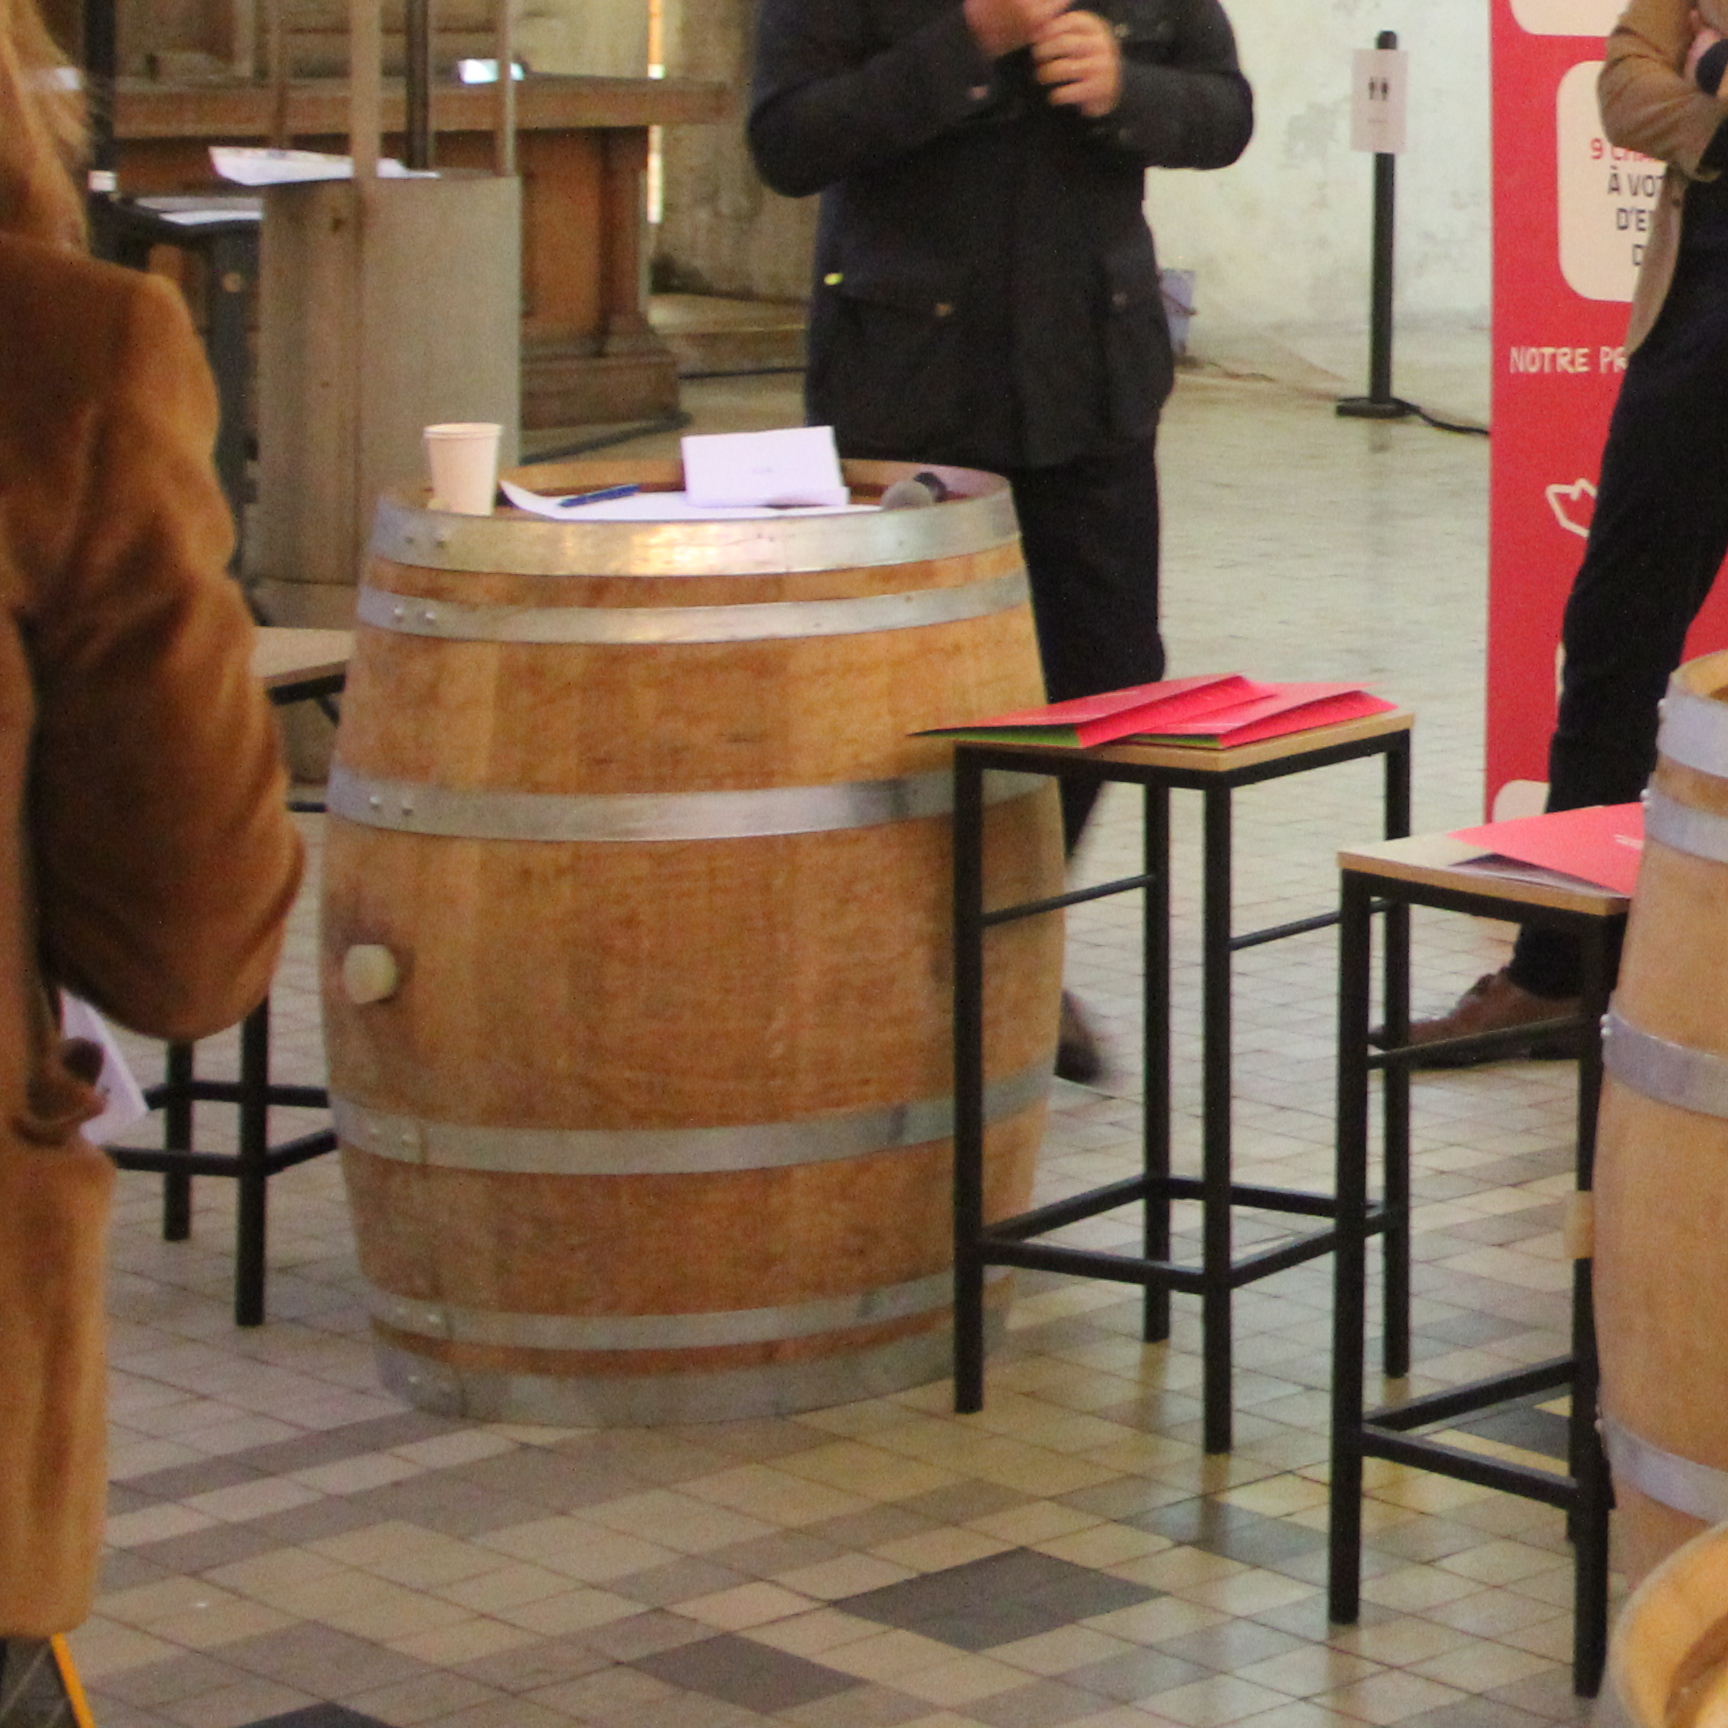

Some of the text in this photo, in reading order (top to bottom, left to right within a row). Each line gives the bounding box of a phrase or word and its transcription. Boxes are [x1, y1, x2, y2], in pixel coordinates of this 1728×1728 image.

[1590, 137, 1604, 160] 9
[1607, 164, 1621, 196] À
[1509, 345, 1591, 374] NOTRE
